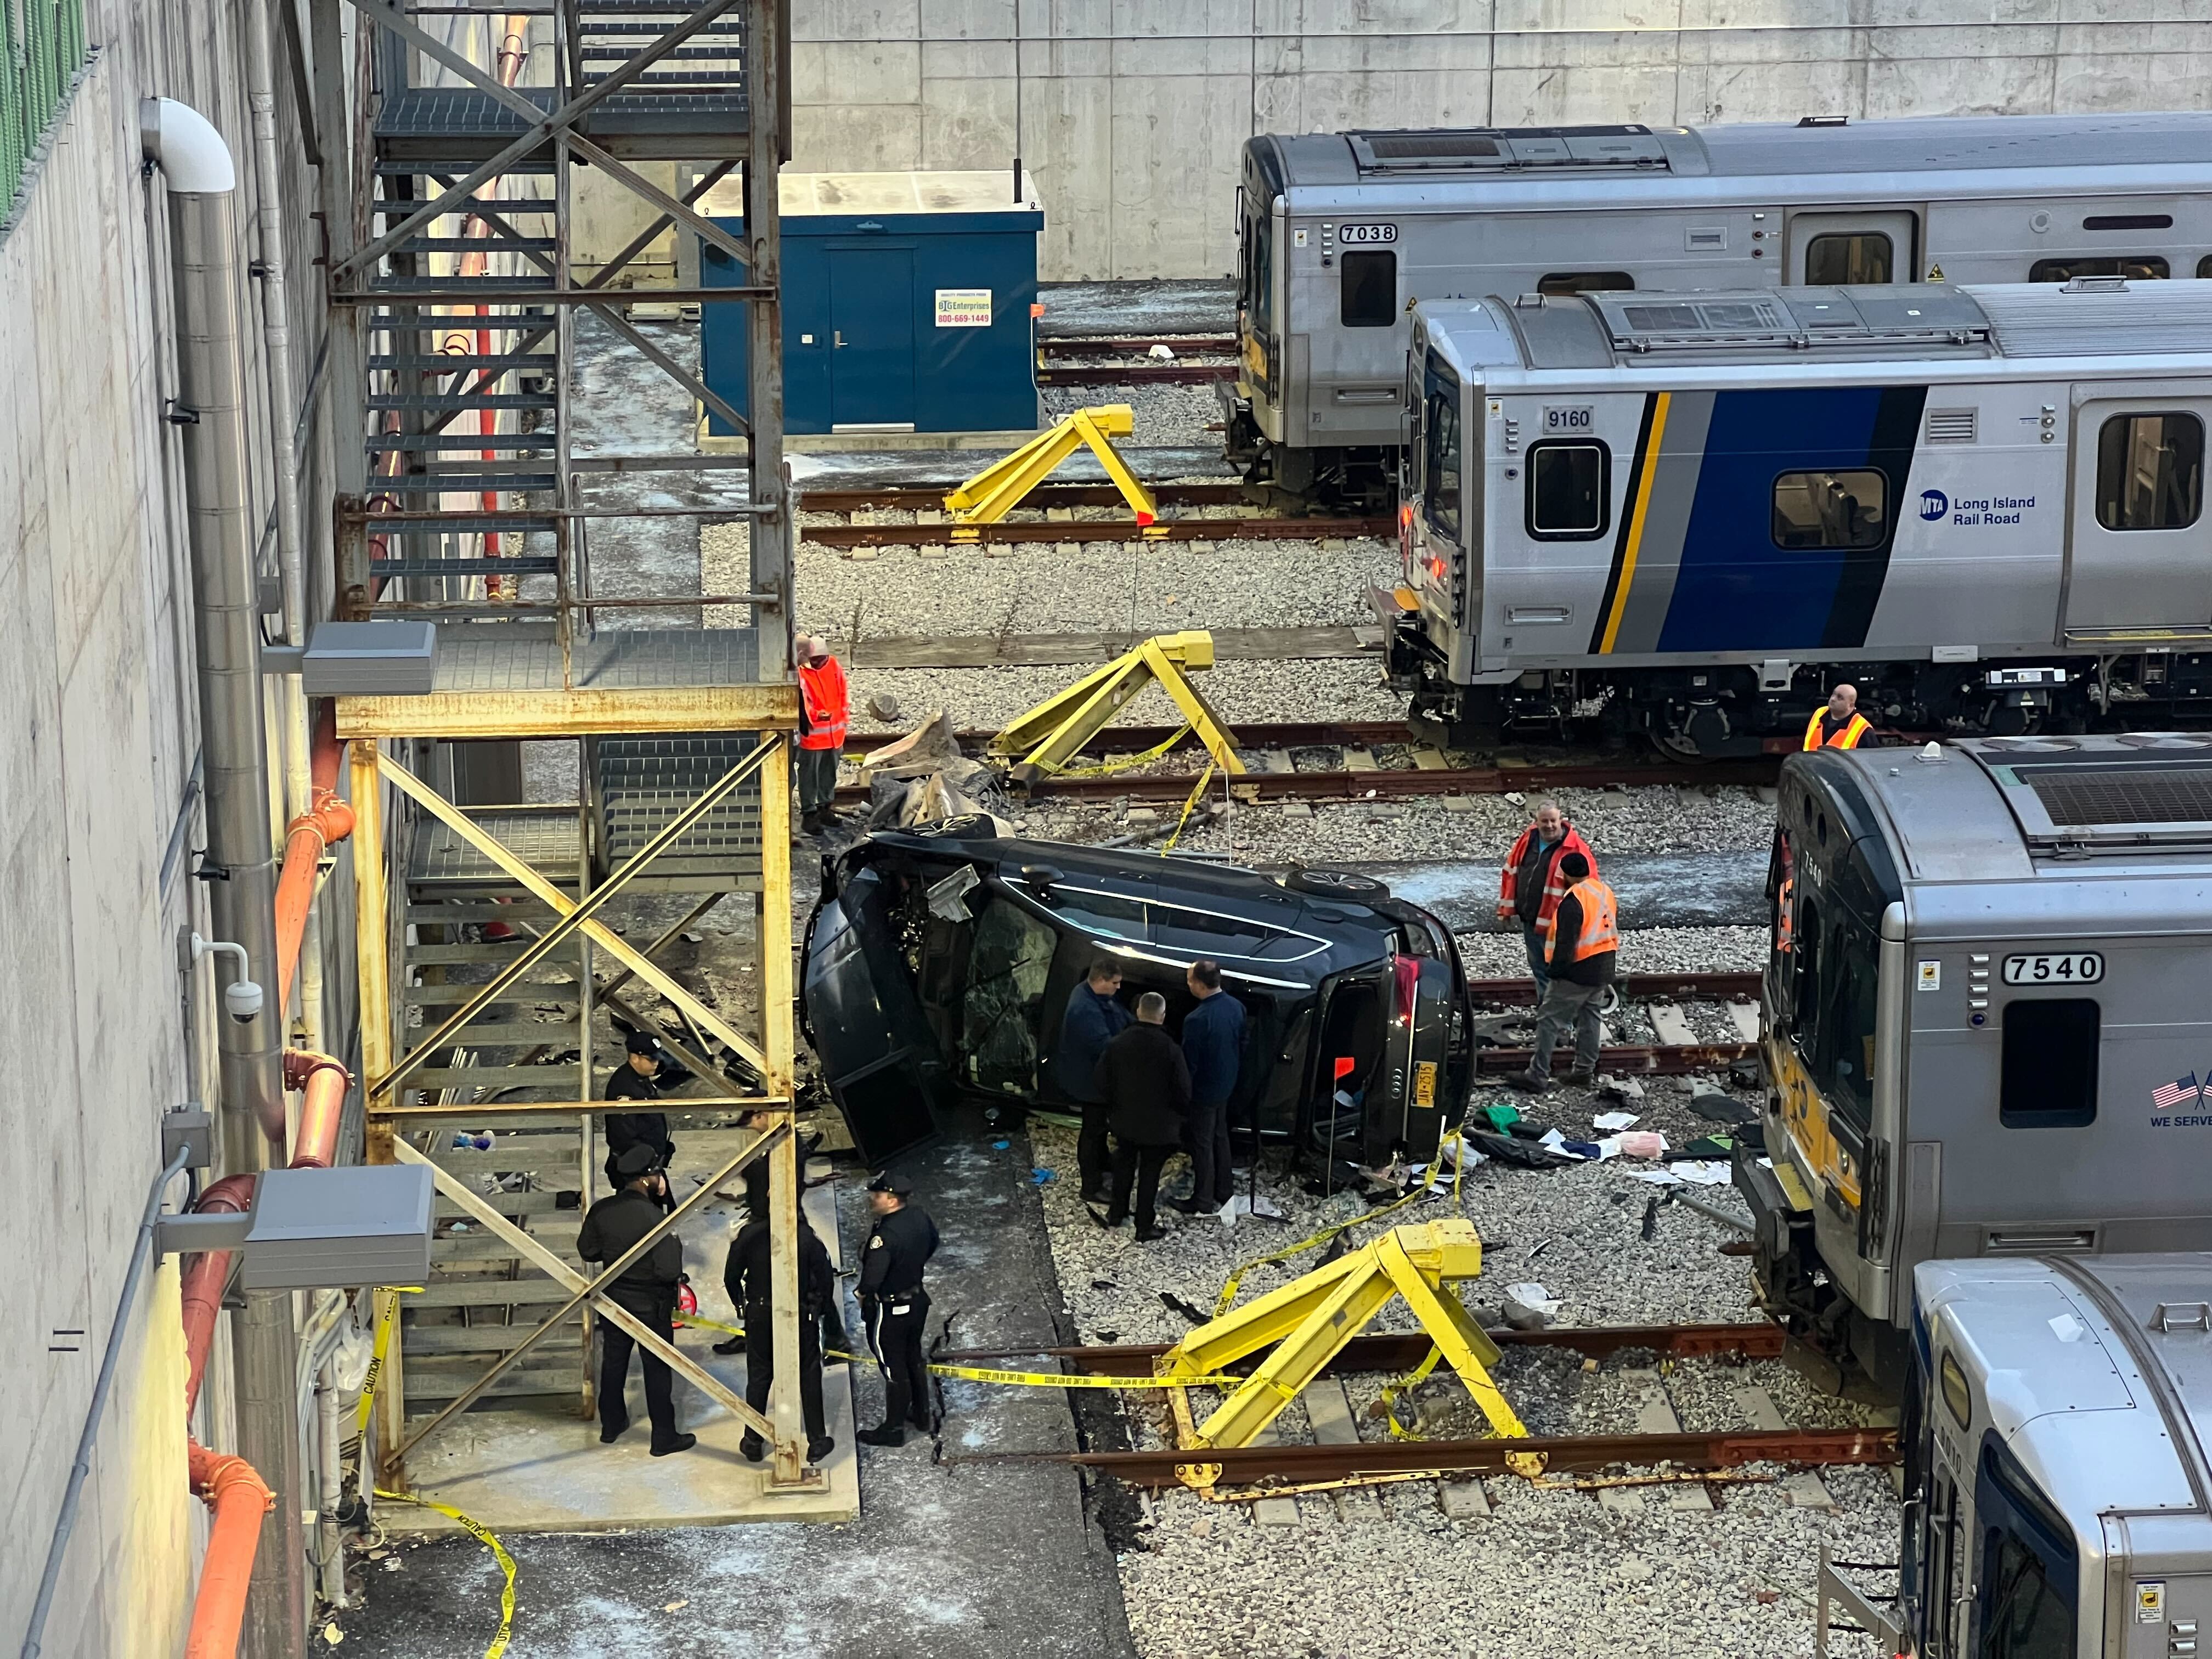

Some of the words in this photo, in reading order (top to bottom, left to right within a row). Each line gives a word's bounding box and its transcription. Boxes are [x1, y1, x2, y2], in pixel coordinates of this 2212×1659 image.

[1345, 226, 1393, 240] 7038
[953, 302, 989, 311] Enterprises
[938, 314, 989, 323] 800-669-1449
[1549, 410, 1589, 427] 9160
[1920, 496, 1943, 515] MTA
[1954, 498, 1989, 512] Long
[1993, 496, 2035, 509] Island
[1954, 514, 1979, 525] Rail
[1984, 512, 2020, 524] Road
[1805, 850, 1822, 888] 7540
[2011, 956, 2096, 980] 7540
[2151, 1117, 2170, 1127] WE
[364, 1356, 381, 1394] CAUTION
[455, 1515, 487, 1536] CAUTION
